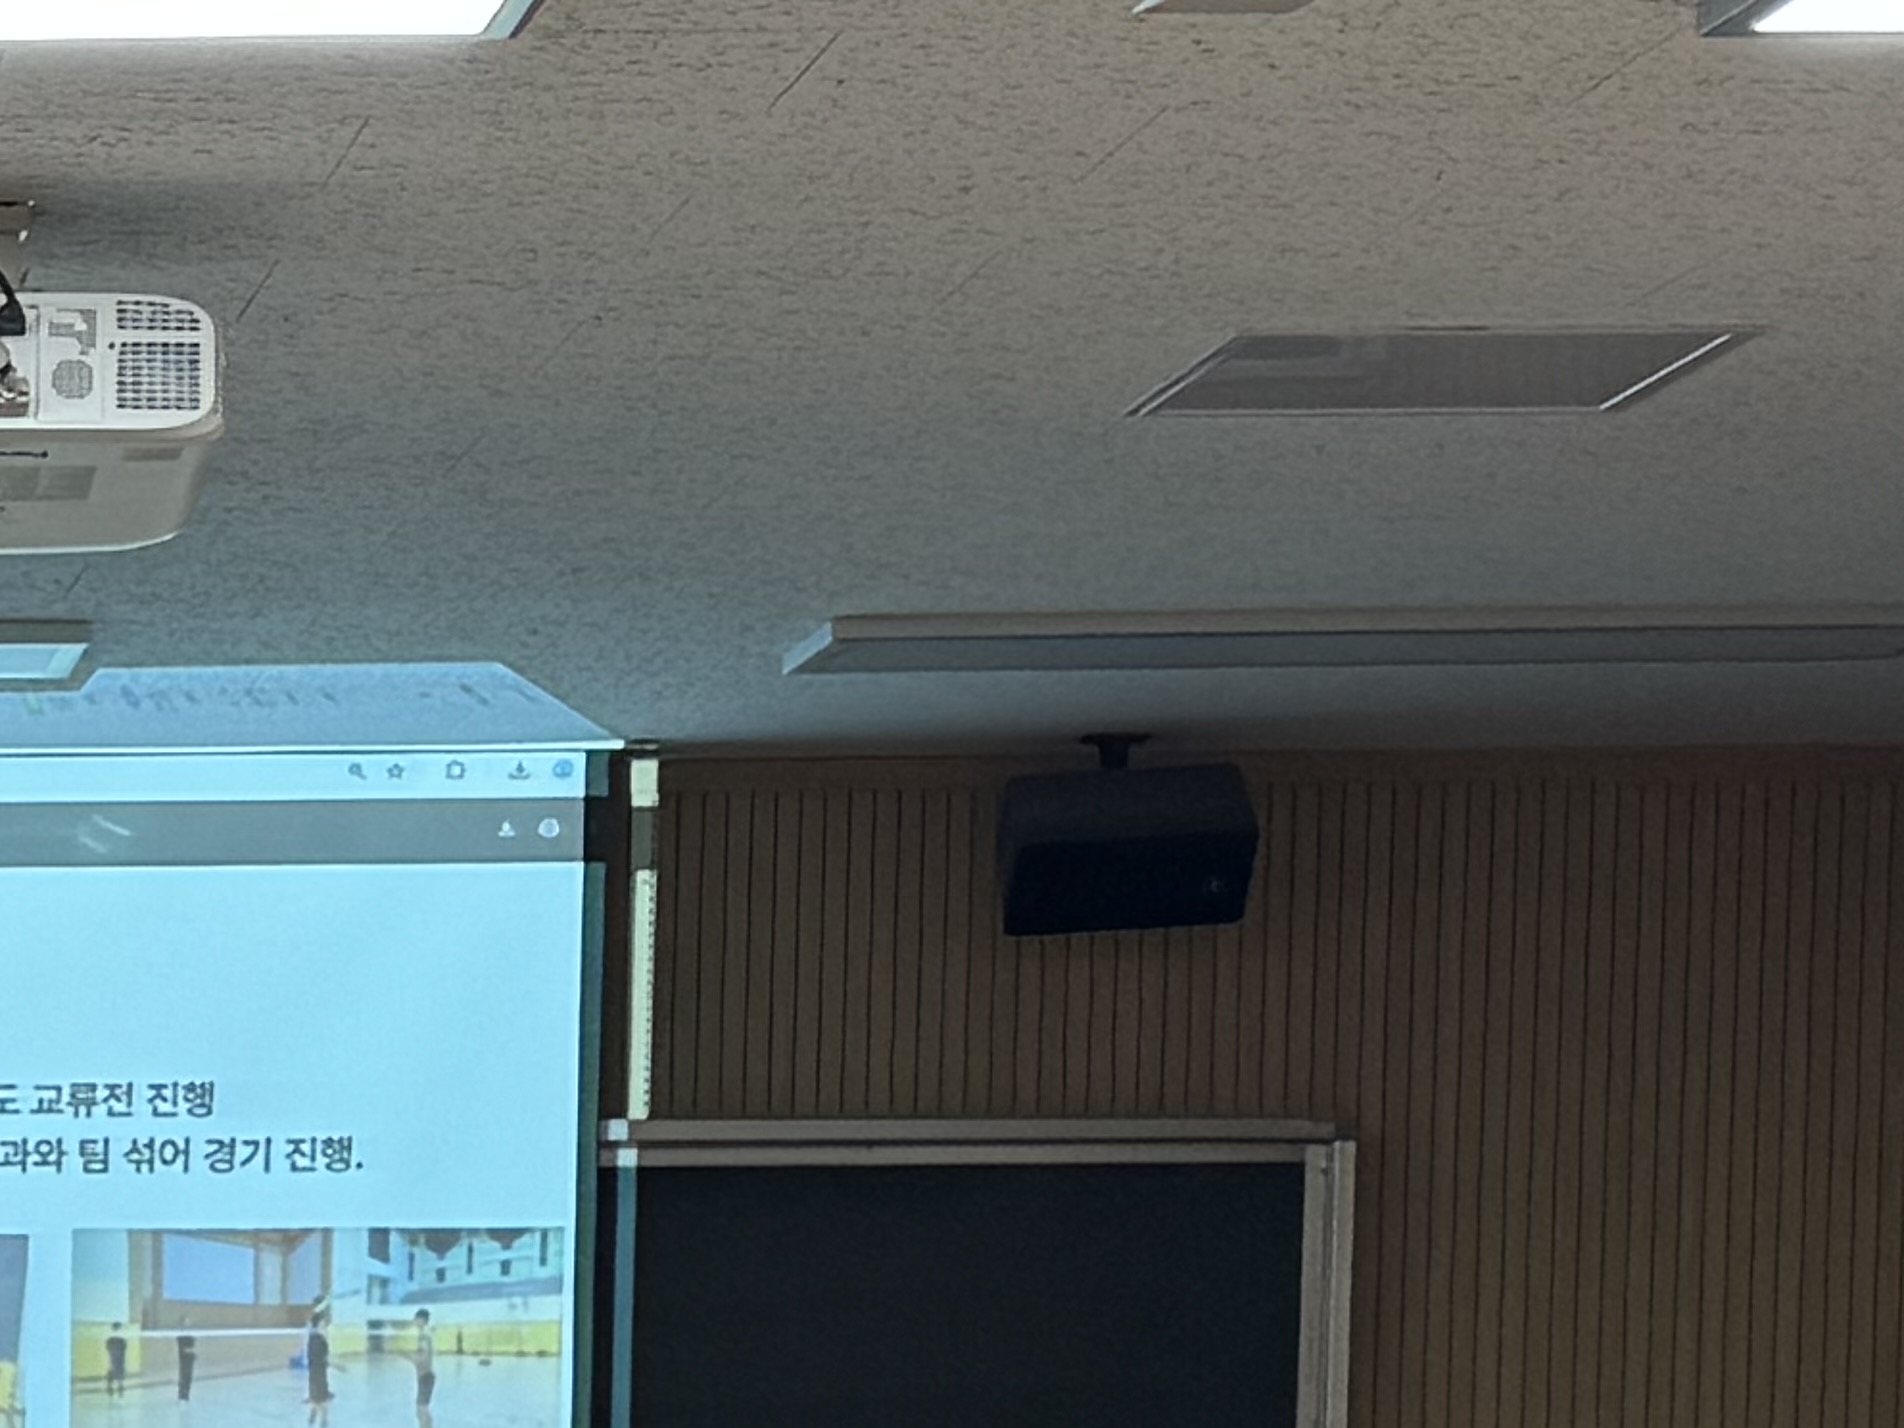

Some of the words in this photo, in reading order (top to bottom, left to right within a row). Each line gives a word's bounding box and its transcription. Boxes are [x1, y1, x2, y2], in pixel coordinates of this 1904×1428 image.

[29, 1081, 133, 1119] 교류전
[147, 1081, 215, 1118] 진행
[79, 1136, 110, 1174] 팀
[123, 1136, 191, 1174] 섞어
[203, 1136, 272, 1174] 경기
[285, 1136, 363, 1173] 진행.
